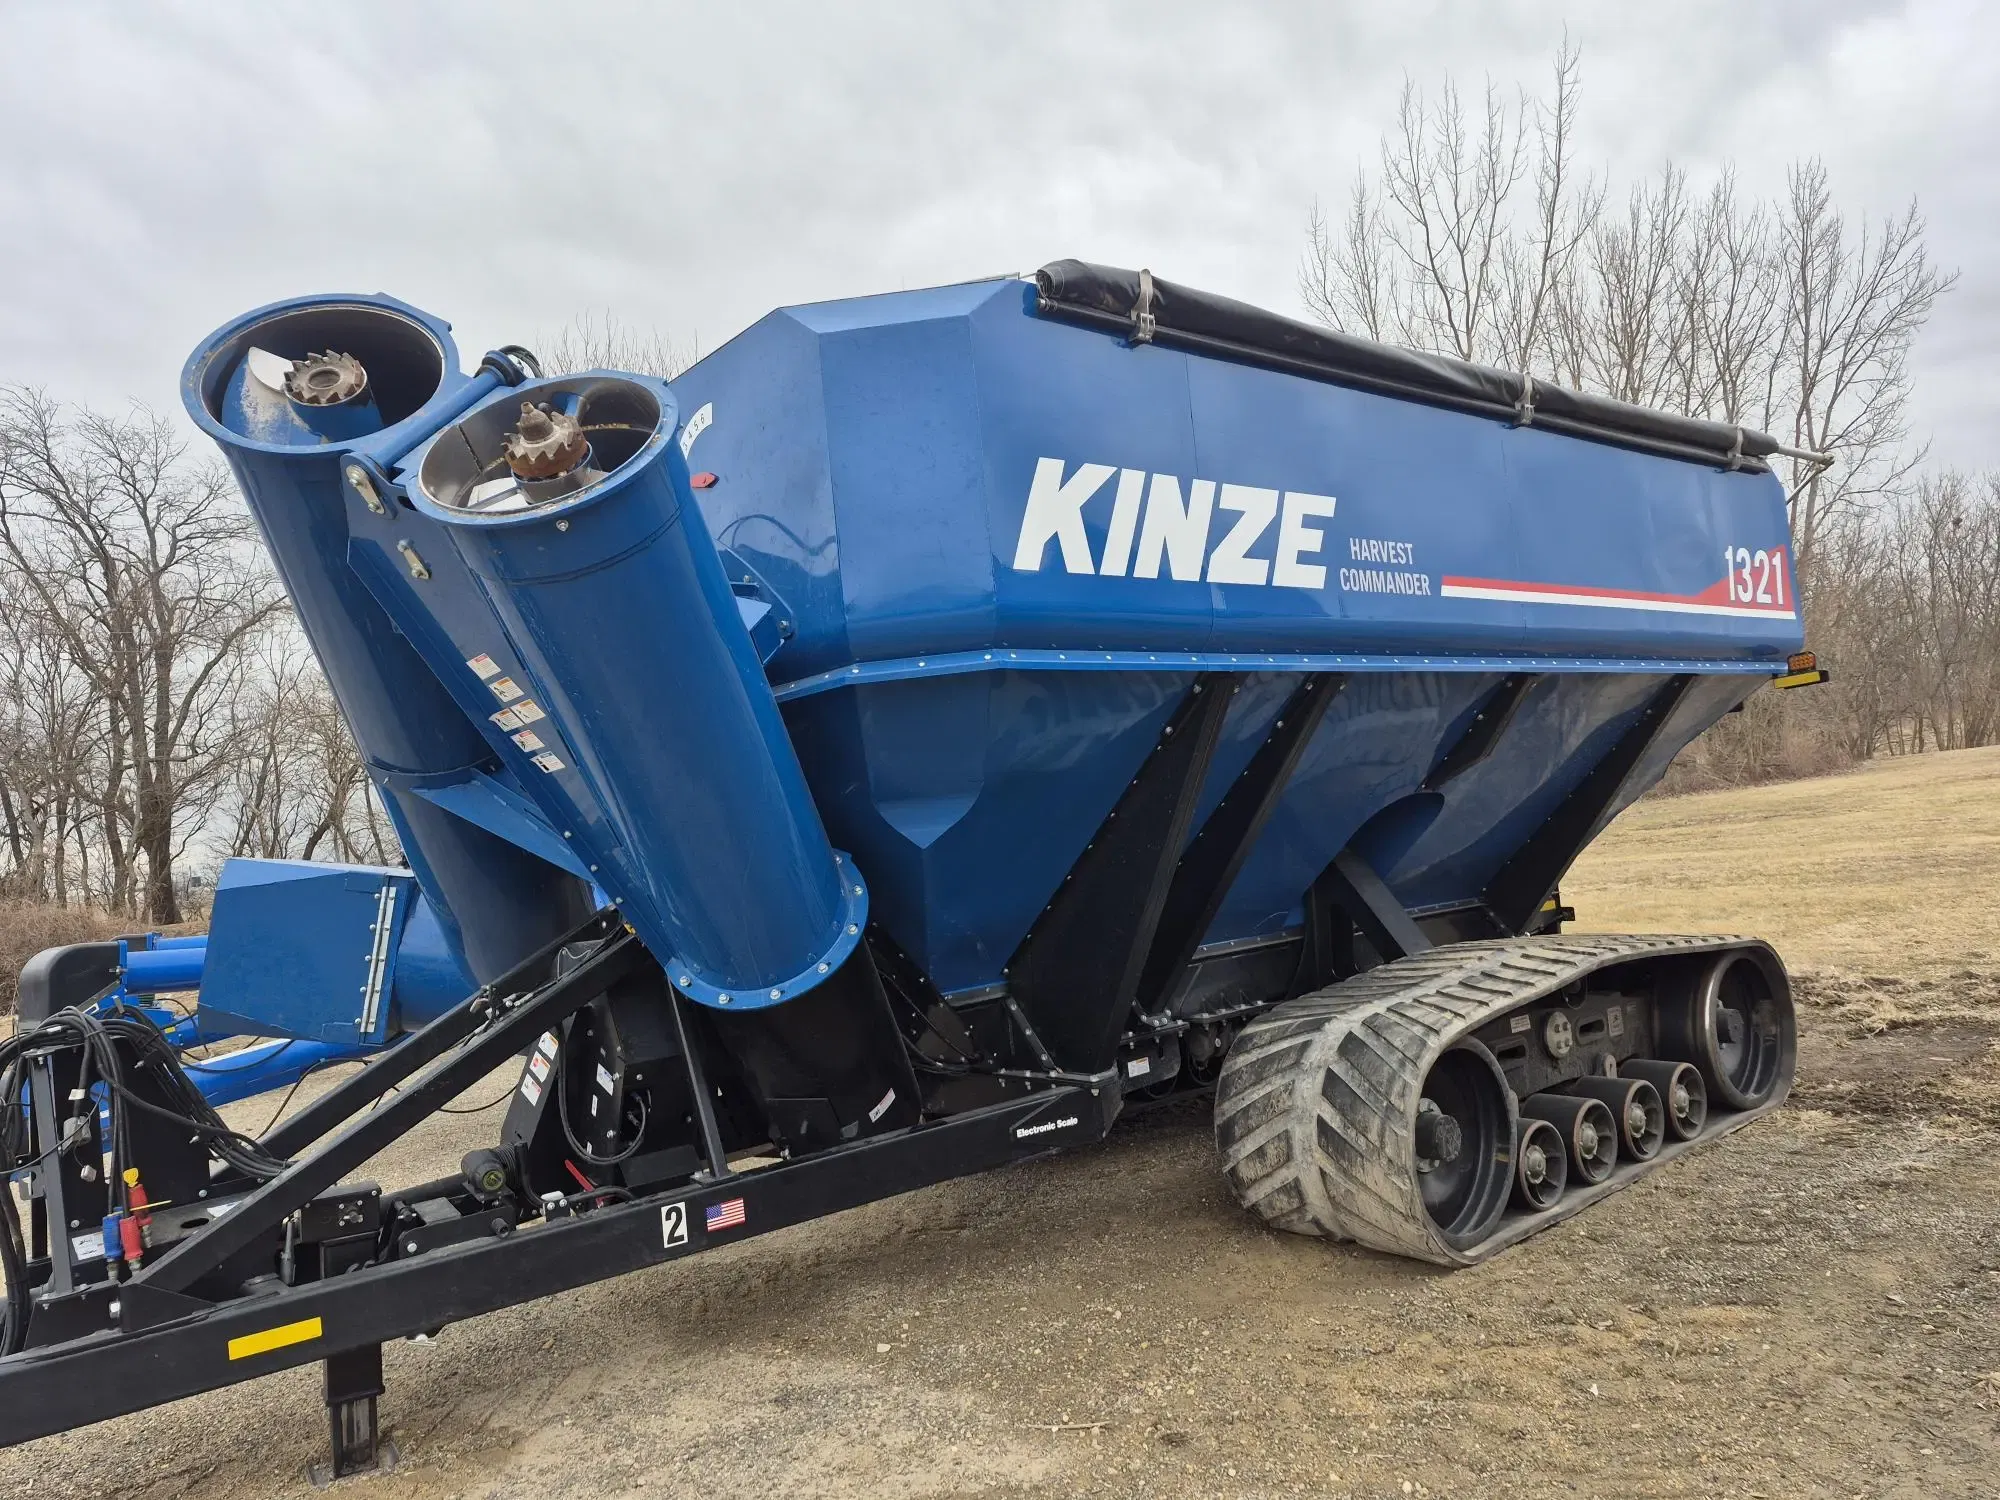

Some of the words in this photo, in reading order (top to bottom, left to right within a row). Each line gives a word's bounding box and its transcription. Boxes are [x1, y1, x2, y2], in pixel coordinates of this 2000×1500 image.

[693, 420, 699, 432] 5
[700, 413, 704, 424] 6
[1013, 457, 1336, 589] KINZE
[1349, 537, 1413, 565] HARVEST
[1340, 567, 1432, 596] COMMANDER
[1724, 545, 1784, 605] 1321
[1016, 1121, 1056, 1138] Electronic
[1056, 1116, 1078, 1128] Scale
[665, 1205, 685, 1245] 2
